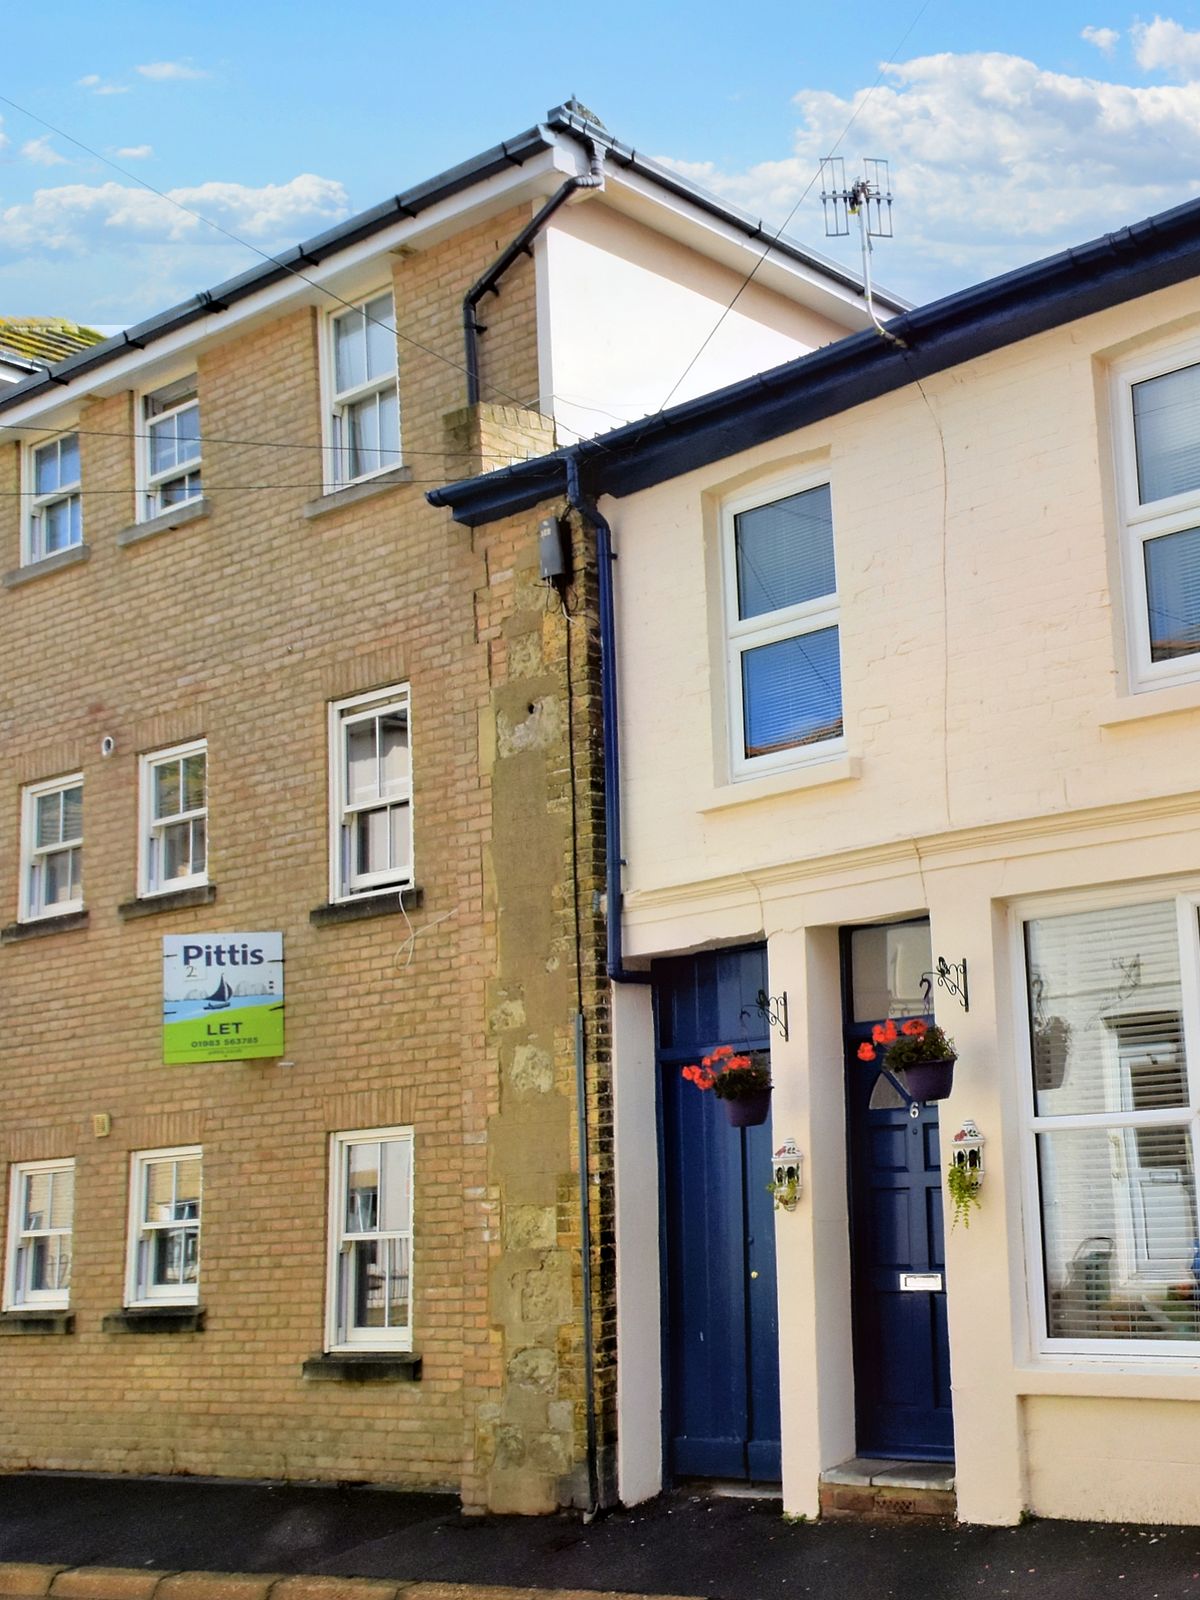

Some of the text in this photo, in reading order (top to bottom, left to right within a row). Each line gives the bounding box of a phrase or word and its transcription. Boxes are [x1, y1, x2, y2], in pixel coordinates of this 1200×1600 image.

[183, 943, 264, 967] Pittis
[207, 1022, 243, 1036] LET
[910, 1101, 919, 1118] 6
